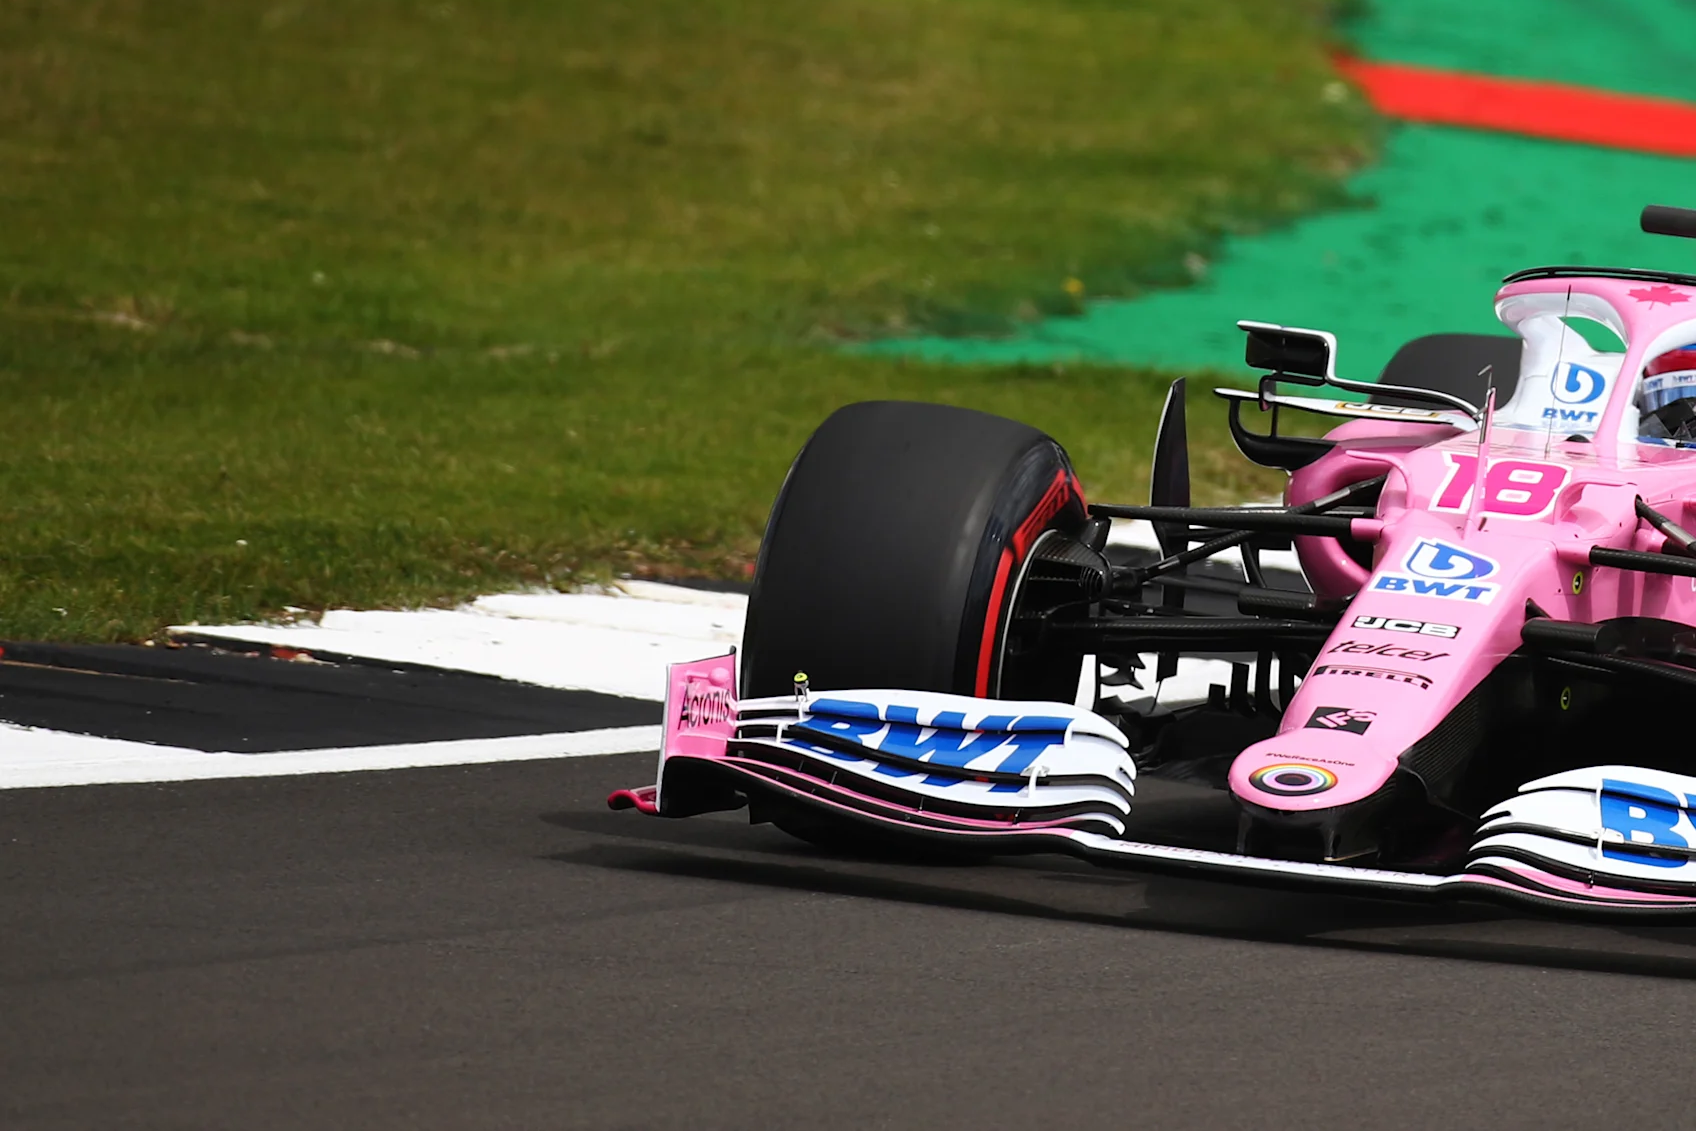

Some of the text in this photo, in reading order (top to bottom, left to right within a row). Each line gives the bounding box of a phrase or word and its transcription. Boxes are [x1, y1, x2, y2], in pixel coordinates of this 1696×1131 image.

[1542, 407, 1598, 423] BWT
[1436, 454, 1568, 516] 18
[1375, 574, 1492, 601] BWT
[1353, 615, 1459, 639] JCB
[1327, 640, 1451, 661] telcel
[1312, 664, 1434, 690] PIRELLI
[677, 687, 731, 731] Acronis
[786, 697, 1075, 794] BWT
[1265, 752, 1356, 767] #WeRaceAsOne
